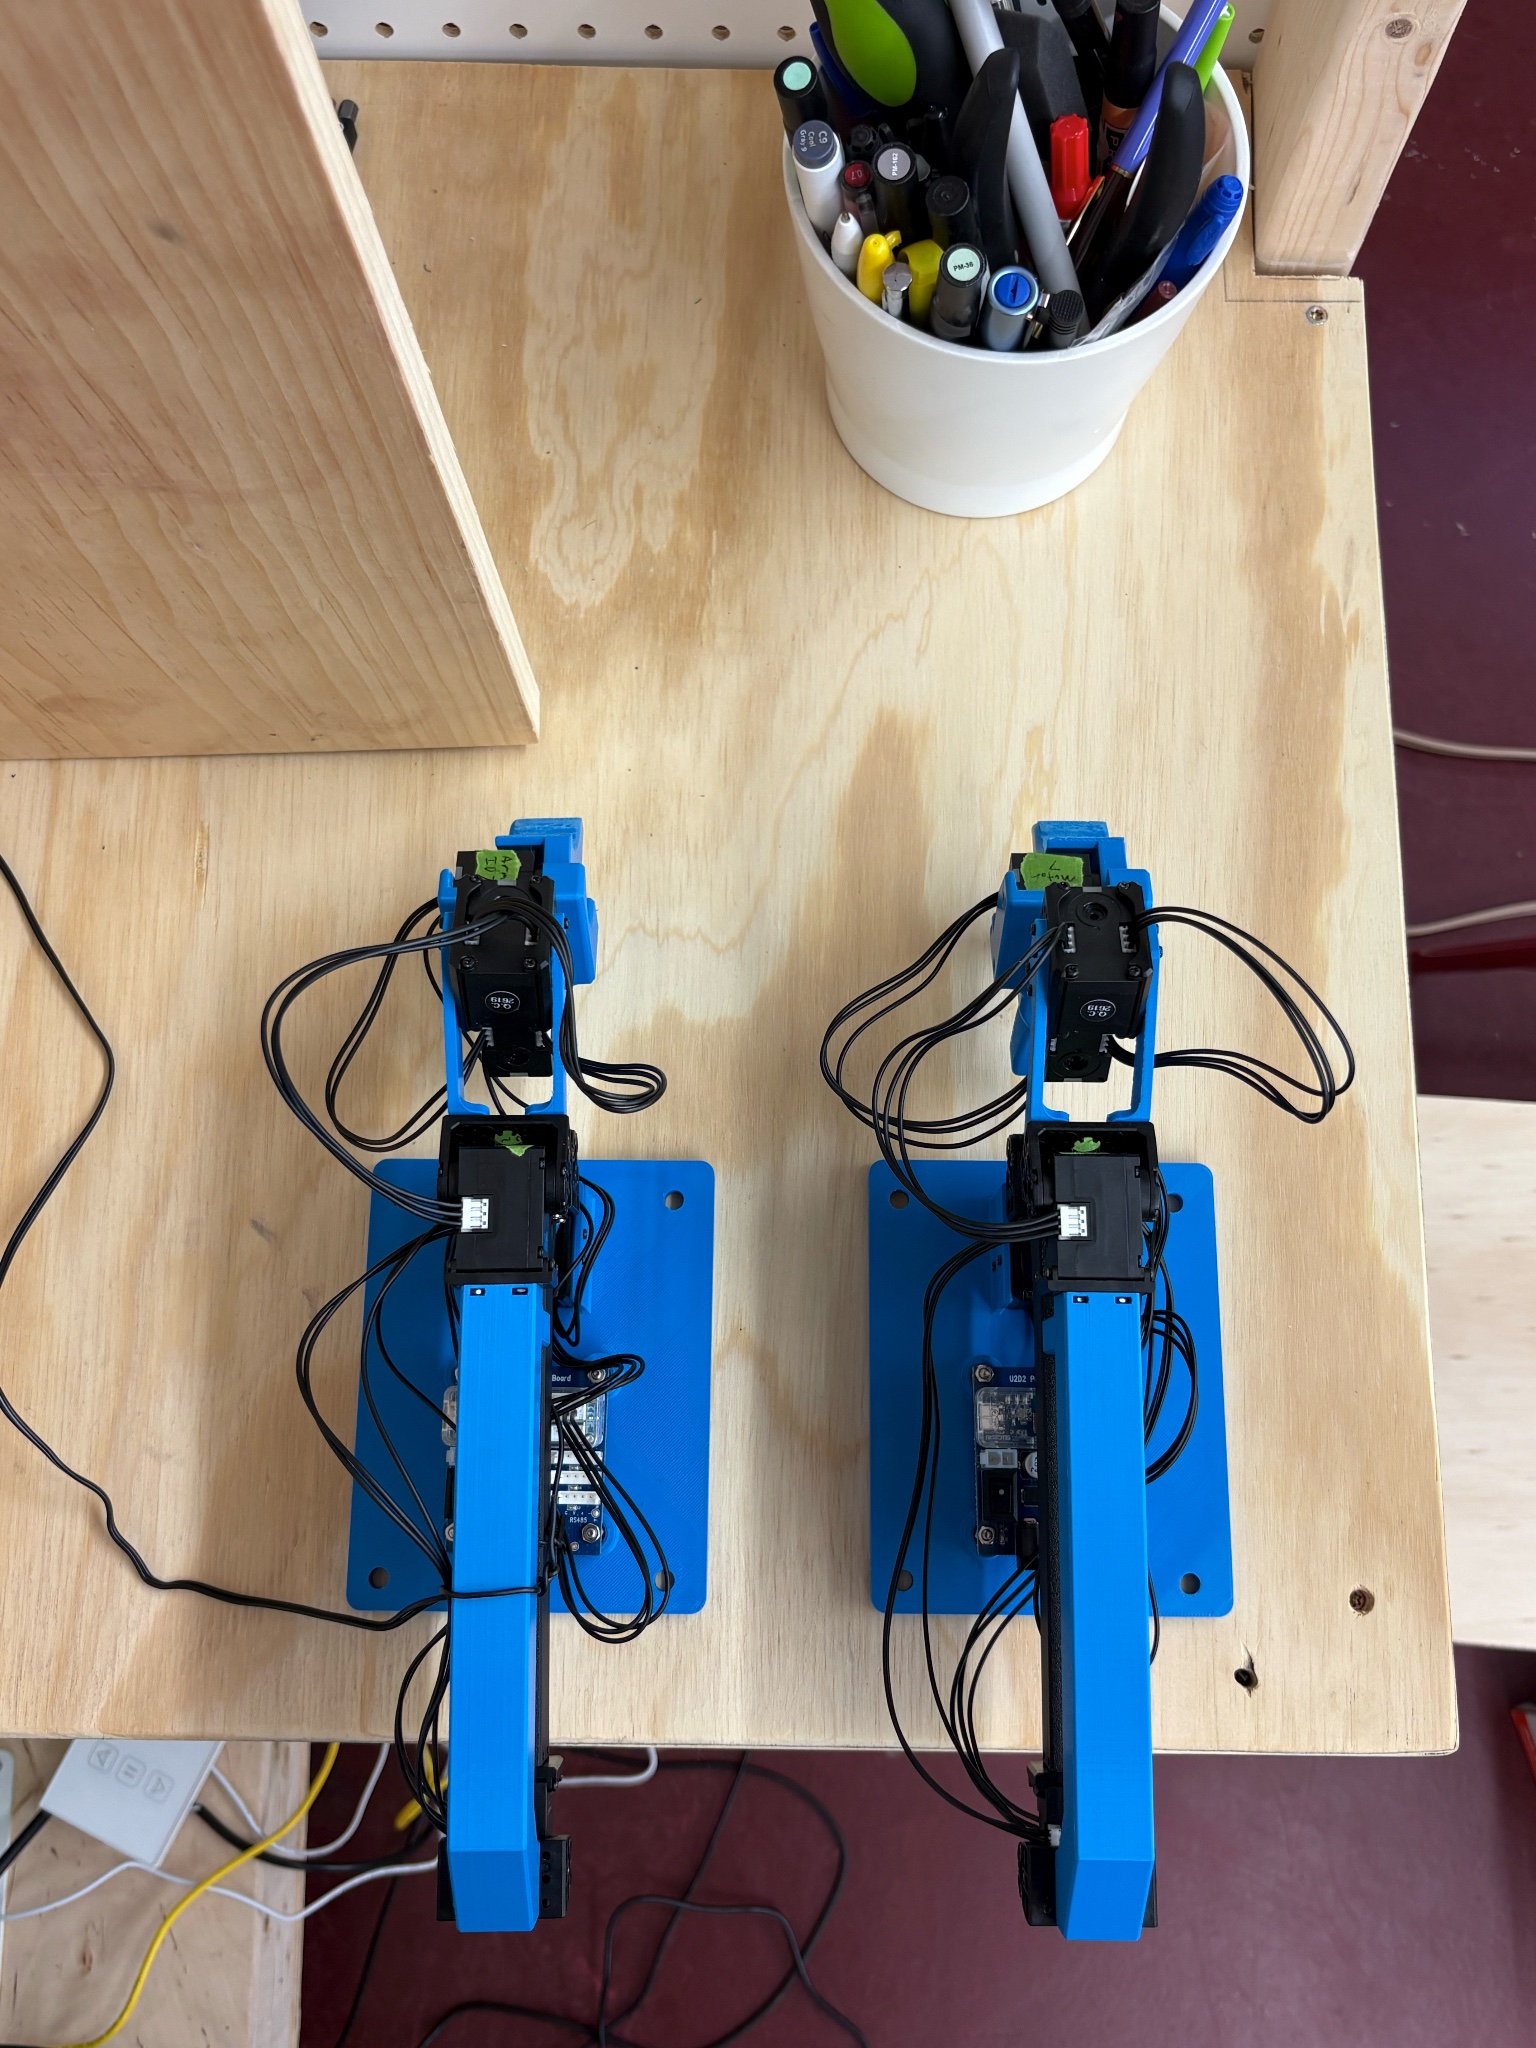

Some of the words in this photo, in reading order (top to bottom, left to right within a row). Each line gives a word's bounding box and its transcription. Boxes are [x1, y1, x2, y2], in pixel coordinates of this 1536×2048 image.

[808, 131, 816, 147] Cool
[818, 130, 828, 144] C9
[891, 152, 899, 176] PM-162
[851, 169, 863, 180] 0.7
[953, 261, 974, 272] PM-36
[1049, 860, 1061, 871] 7
[1031, 872, 1076, 883] Motor
[490, 996, 515, 1004] 2619
[491, 1002, 512, 1010] Q.C.
[1087, 1004, 1112, 1012] 2619
[1086, 1010, 1107, 1018] Q.C.
[551, 1374, 572, 1382] Board
[1009, 1374, 1027, 1383] U2D2
[569, 1516, 588, 1524] RS485
